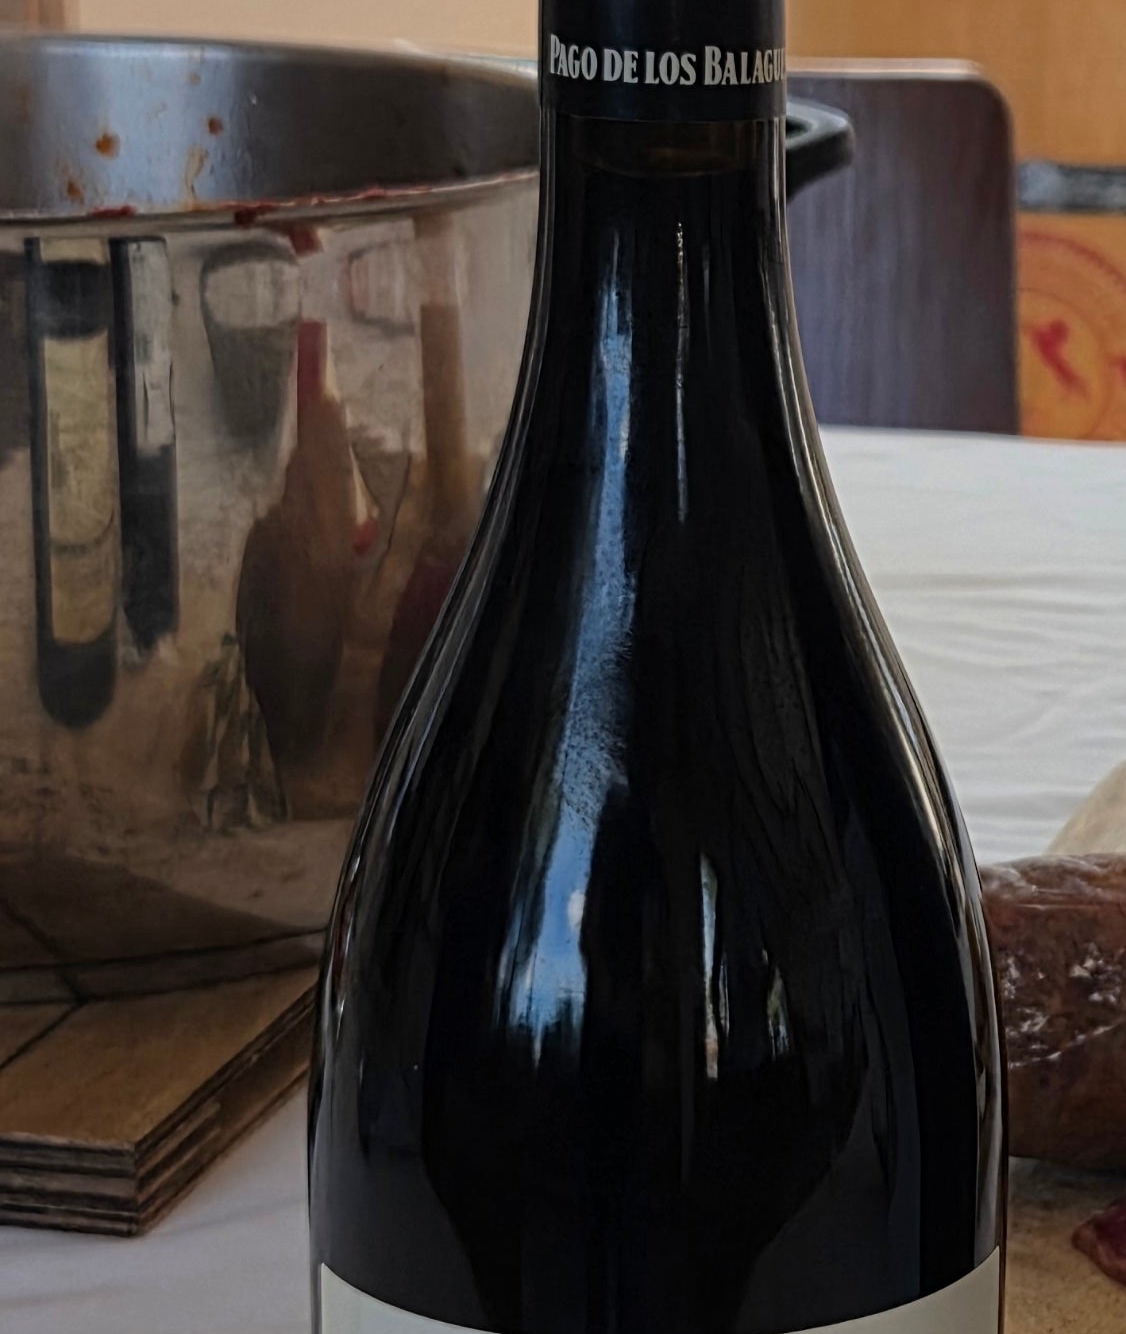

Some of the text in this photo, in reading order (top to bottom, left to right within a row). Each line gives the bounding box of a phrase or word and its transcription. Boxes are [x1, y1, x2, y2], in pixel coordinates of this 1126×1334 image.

[550, 33, 598, 80] PAGO
[603, 48, 639, 84] DE
[644, 50, 697, 86] LOS
